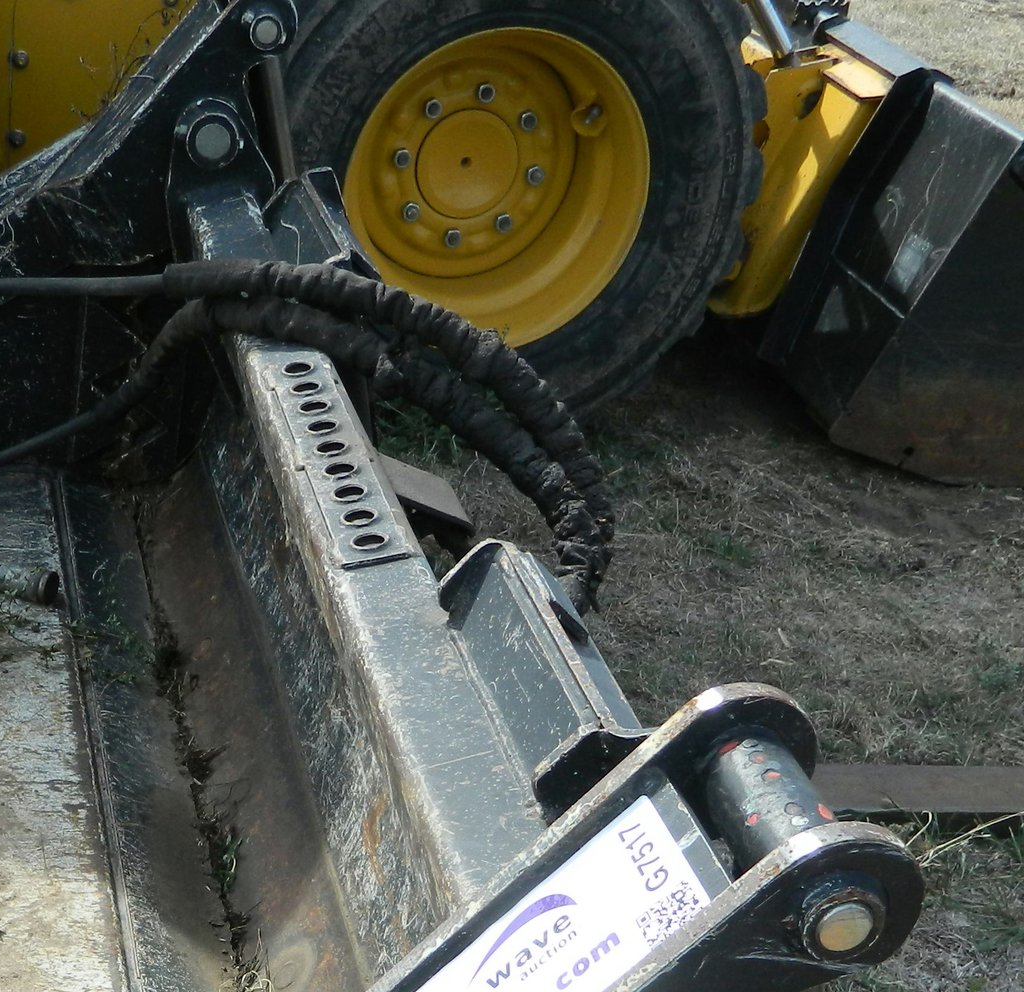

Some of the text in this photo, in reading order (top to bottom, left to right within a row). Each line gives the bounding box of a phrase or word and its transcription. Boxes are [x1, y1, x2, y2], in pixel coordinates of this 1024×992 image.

[618, 822, 669, 892] G7517
[485, 914, 572, 989] wave
[519, 930, 578, 982] auction
